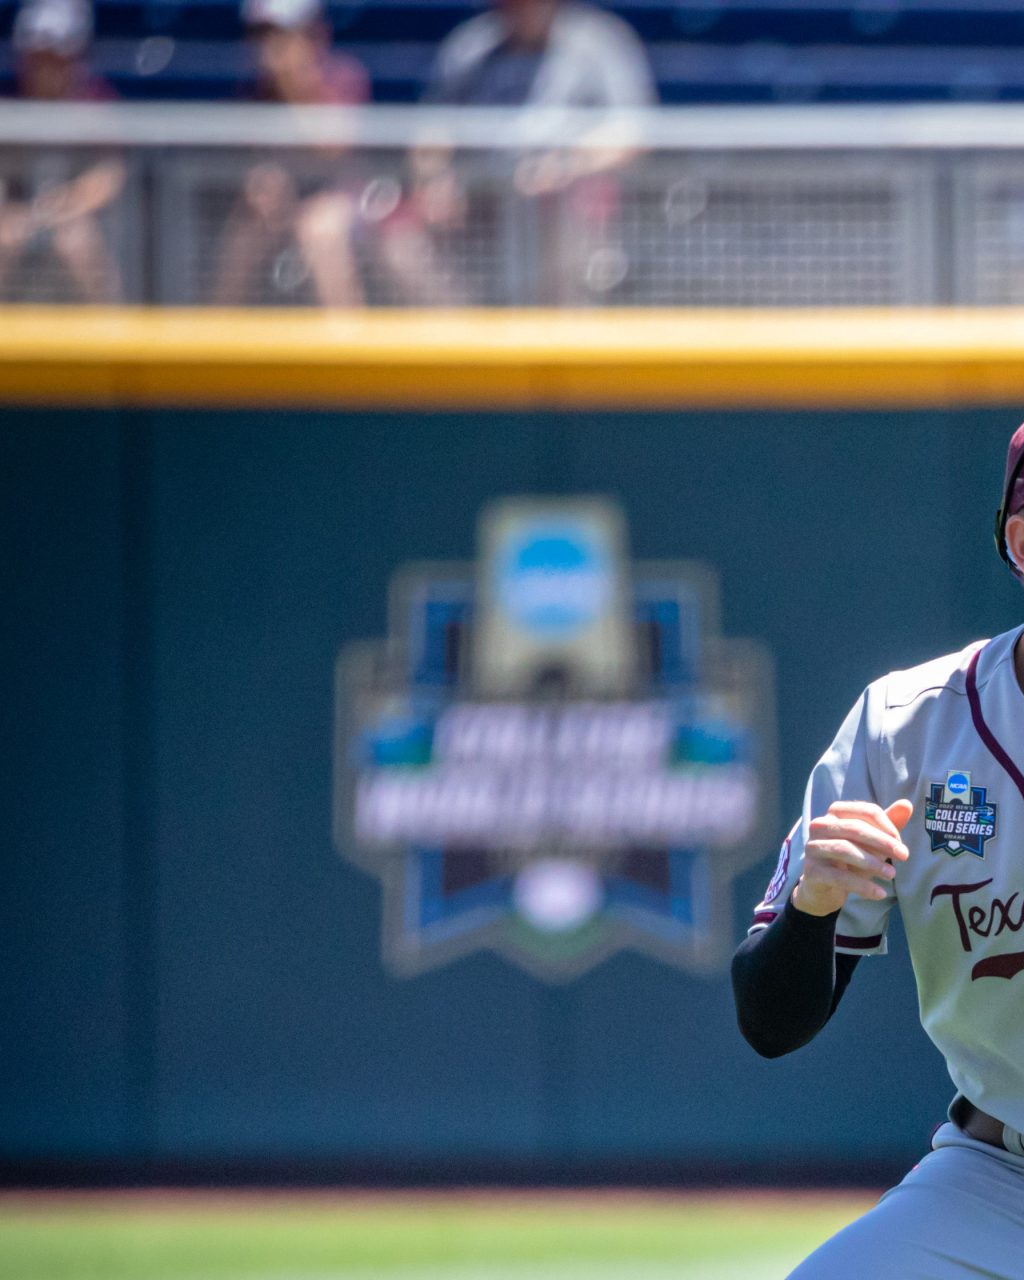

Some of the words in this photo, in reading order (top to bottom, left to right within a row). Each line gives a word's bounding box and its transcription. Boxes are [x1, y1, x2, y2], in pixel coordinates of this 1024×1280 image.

[935, 809, 978, 822] COLLEGE
[926, 819, 954, 833] WORLD
[955, 823, 993, 836] SERIES
